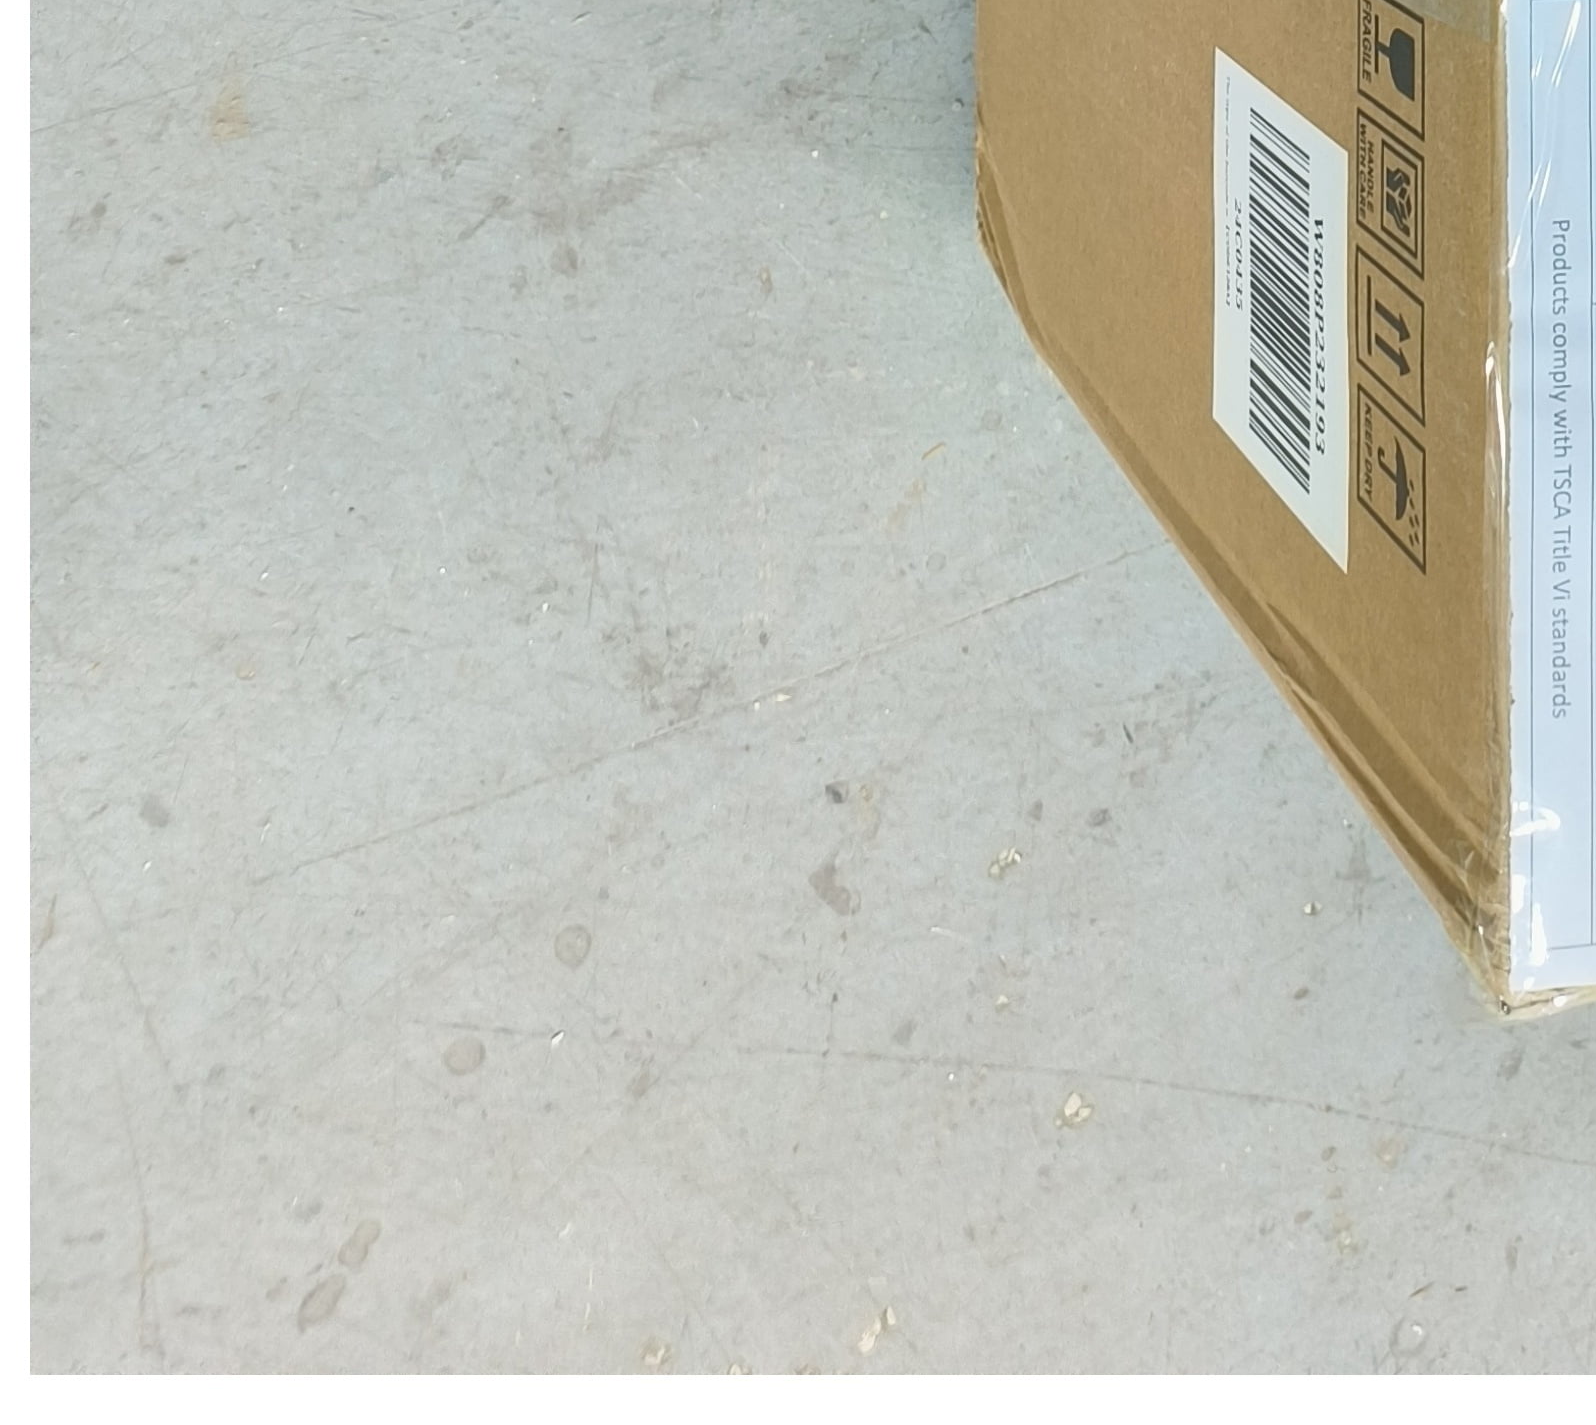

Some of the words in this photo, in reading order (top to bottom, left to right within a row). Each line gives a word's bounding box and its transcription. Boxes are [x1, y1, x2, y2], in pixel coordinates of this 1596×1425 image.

[1552, 219, 1571, 314] Products
[1313, 218, 1326, 455] W808P232193
[1548, 322, 1571, 402] comply
[1364, 403, 1373, 457] KEEP
[1553, 409, 1573, 458] with
[1364, 458, 1373, 502] DRY
[1553, 464, 1572, 519] TSCA
[1552, 525, 1572, 573] Title
[1552, 579, 1572, 601] Vi
[1551, 608, 1572, 719] standards
